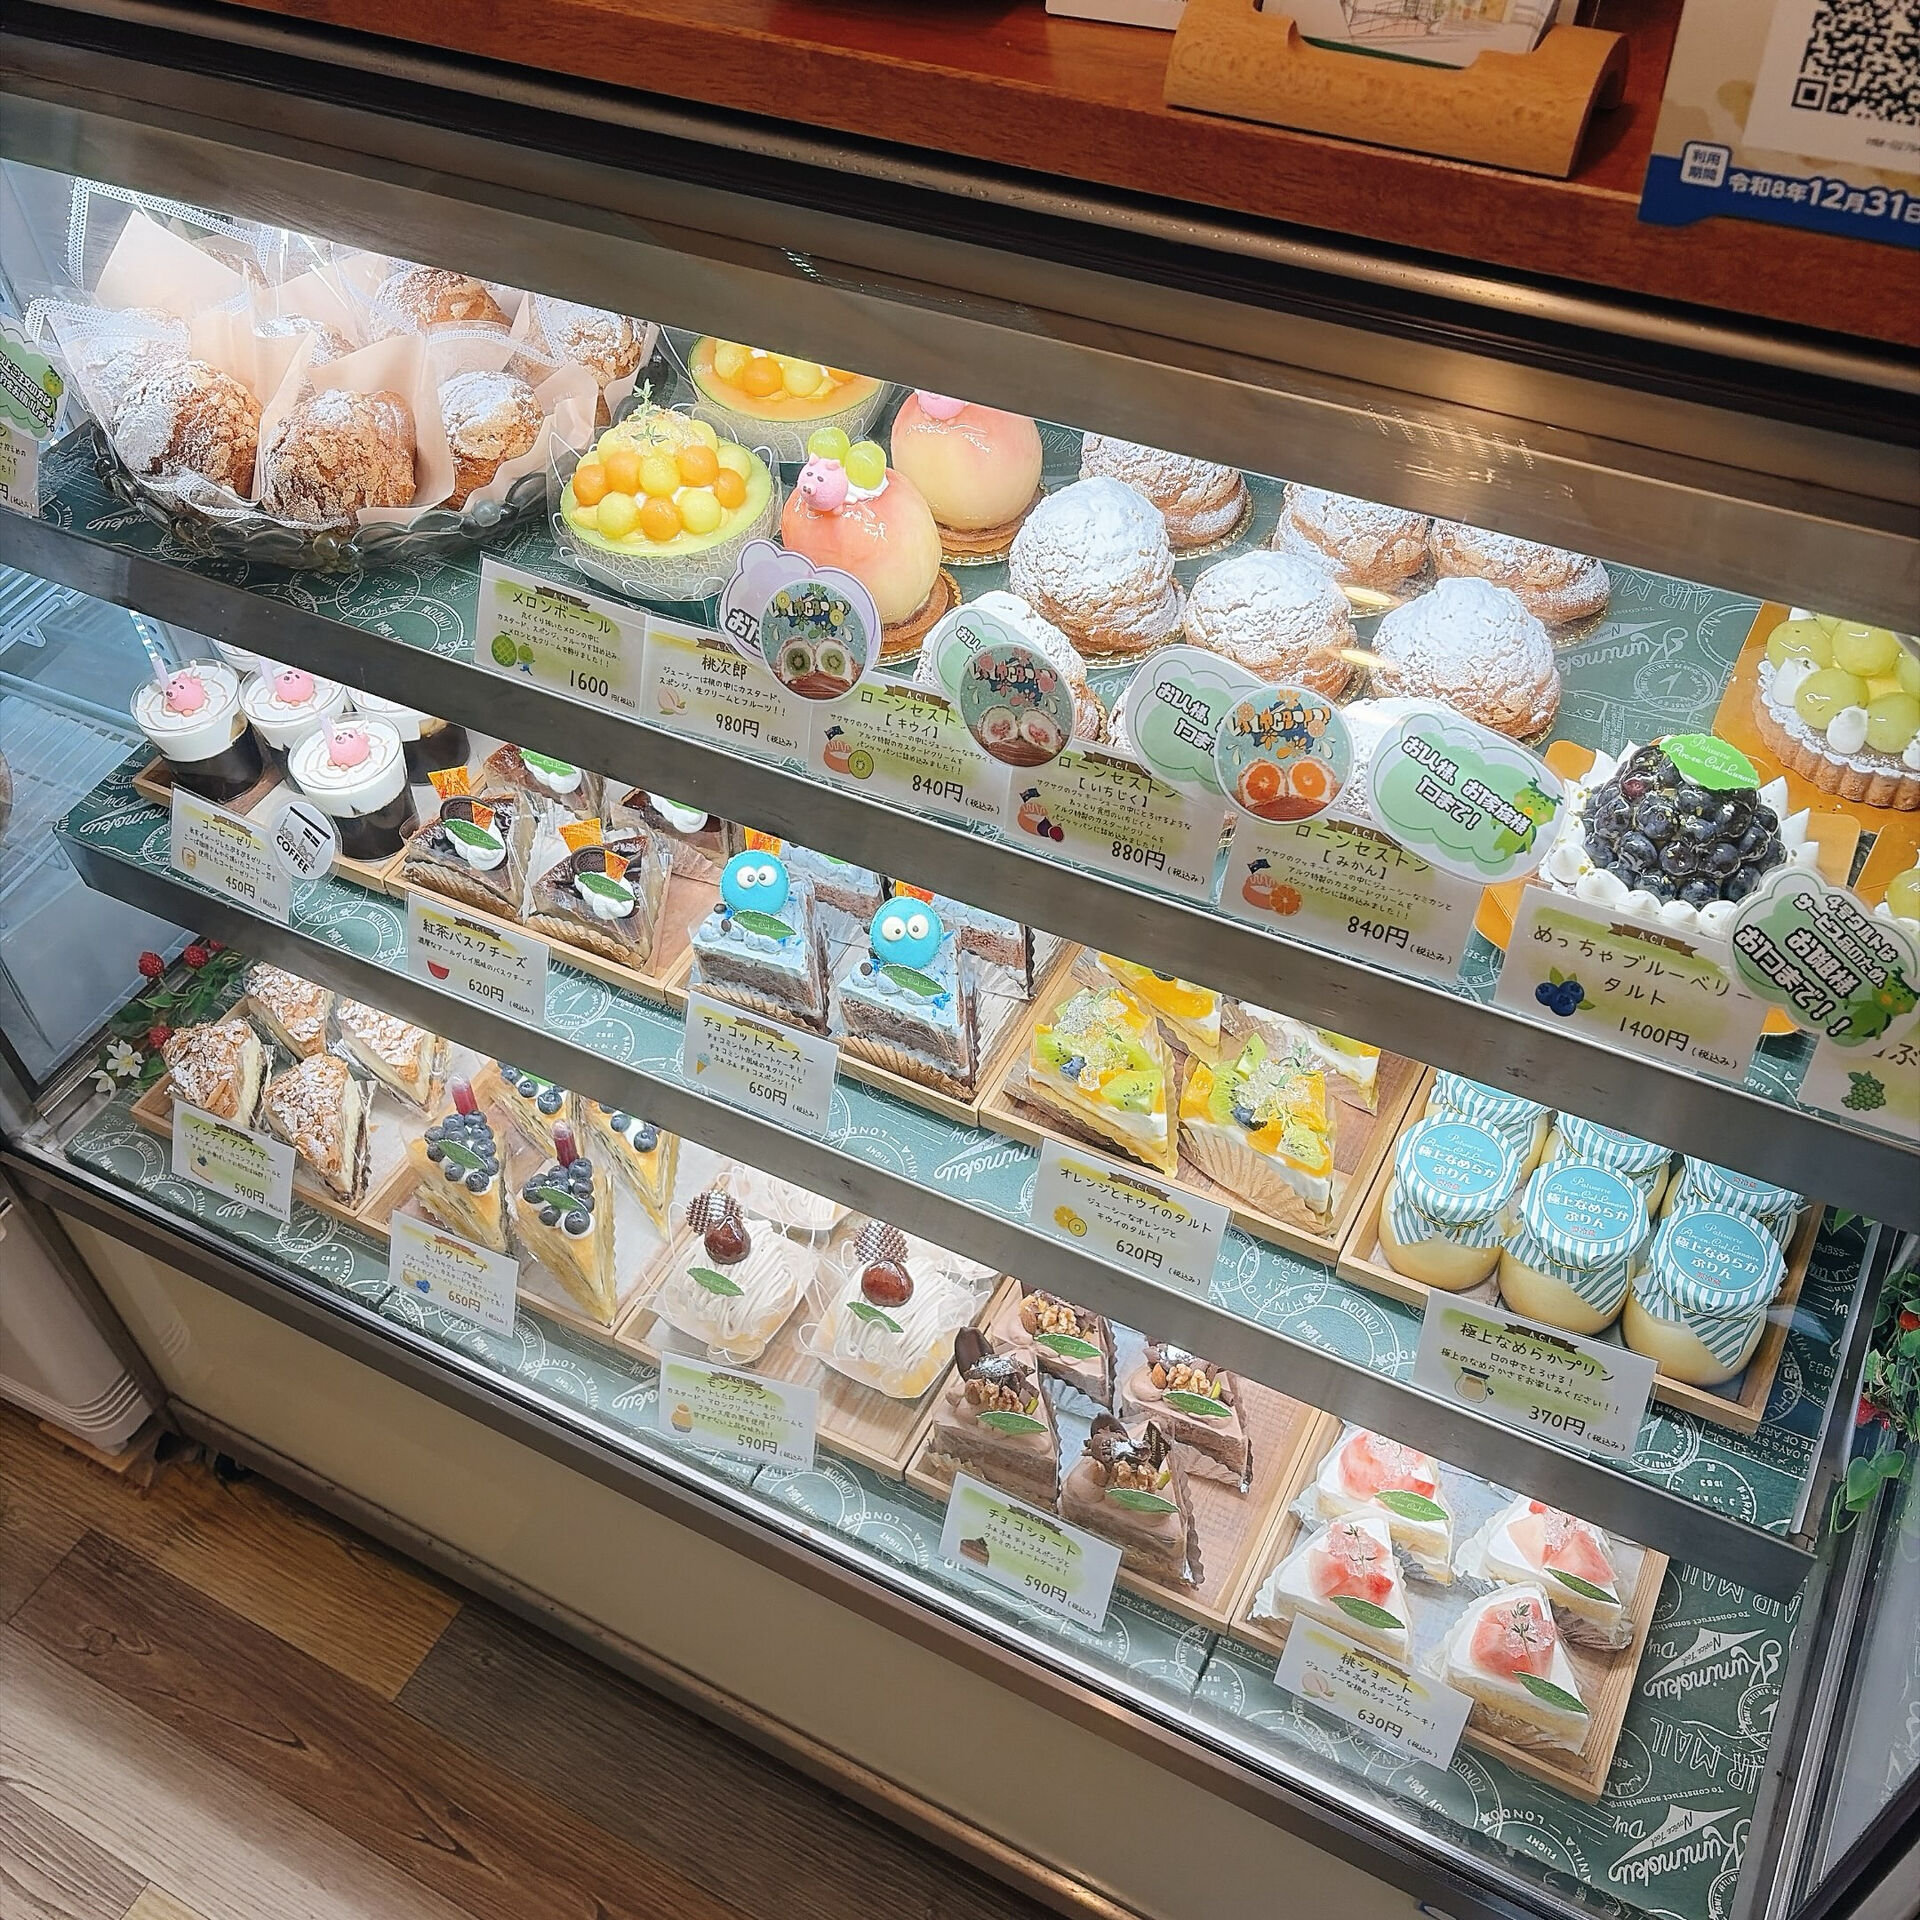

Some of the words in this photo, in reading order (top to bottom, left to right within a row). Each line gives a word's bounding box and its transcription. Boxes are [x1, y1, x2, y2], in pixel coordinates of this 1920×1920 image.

[1688, 166, 1717, 181] 期間
[1692, 151, 1721, 166] 利用
[701, 654, 748, 681] 桃次郎
[715, 713, 760, 739] 980円
[911, 774, 964, 803] 840円
[202, 819, 261, 851] コーヒーゼリー
[276, 835, 310, 874] COFFEE
[1111, 840, 1166, 871] 880円
[225, 875, 256, 899] 450円
[422, 918, 528, 969] 紅茶バスクチーズ
[1346, 915, 1409, 949] 840円
[1824, 894, 1899, 963] 4号タルトは
[1533, 924, 1753, 1000] めっちゃブルーベリー
[468, 978, 504, 1003] 620円
[1604, 976, 1667, 1006] タルト
[703, 1016, 815, 1064] チョコットスースー
[1618, 1016, 1690, 1052] 1400円
[749, 1081, 788, 1106] 650円
[193, 1123, 275, 1162] インディアンサマー
[1418, 1144, 1497, 1179] 極上なめらか
[1433, 1162, 1471, 1185] ぷりん
[234, 1182, 265, 1204] 590円
[1060, 1167, 1212, 1234] オレンジとキウイのタルト
[1546, 1192, 1629, 1222] 極上なめらか
[1087, 1197, 1176, 1239] ジューシーなオレンジと
[1097, 1212, 1161, 1244] キウイのタルト！
[1564, 1210, 1605, 1230] ぷりん
[423, 1240, 488, 1273] ミルクレープ
[1115, 1239, 1163, 1269] 620円
[1674, 1235, 1759, 1274] 極上なめらか
[1690, 1256, 1732, 1279] ぷりん
[448, 1290, 481, 1313] 650円
[1460, 1321, 1615, 1382] 極上なめらかプリン
[1440, 1347, 1620, 1414] 極上のなめらかさをお楽しみください！！
[1490, 1352, 1574, 1387] 口の中でとろける！
[706, 1377, 767, 1400] モンブラン
[1528, 1405, 1586, 1437] 370円
[737, 1434, 778, 1455] 590円
[988, 1508, 1077, 1557] チョコショート
[1023, 1574, 1067, 1603] 590円
[1340, 1651, 1414, 1694] 桃ショート
[1643, 1638, 1782, 1701] Kumimoku
[1357, 1708, 1403, 1739] 630円
[1650, 1716, 1720, 1780] MAIL
[1662, 1787, 1710, 1802] construct
[1610, 1818, 1647, 1839] Diy
